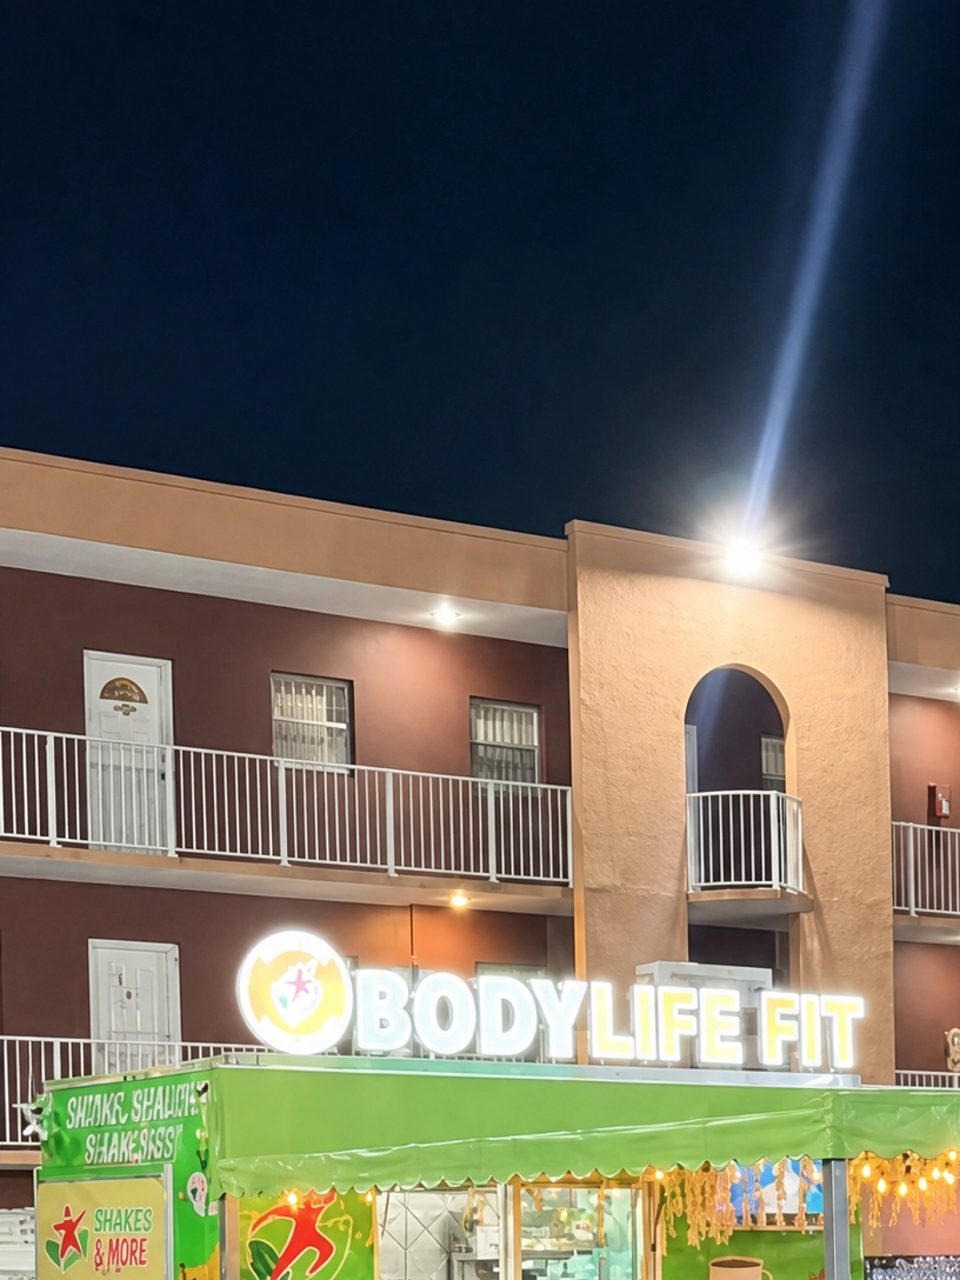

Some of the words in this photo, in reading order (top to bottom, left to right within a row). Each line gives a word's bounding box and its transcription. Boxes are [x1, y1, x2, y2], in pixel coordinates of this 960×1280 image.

[761, 991, 864, 1068] FIT
[94, 1208, 153, 1232] SHAKES
[94, 1238, 104, 1268] &
[107, 1237, 148, 1267] MORE
